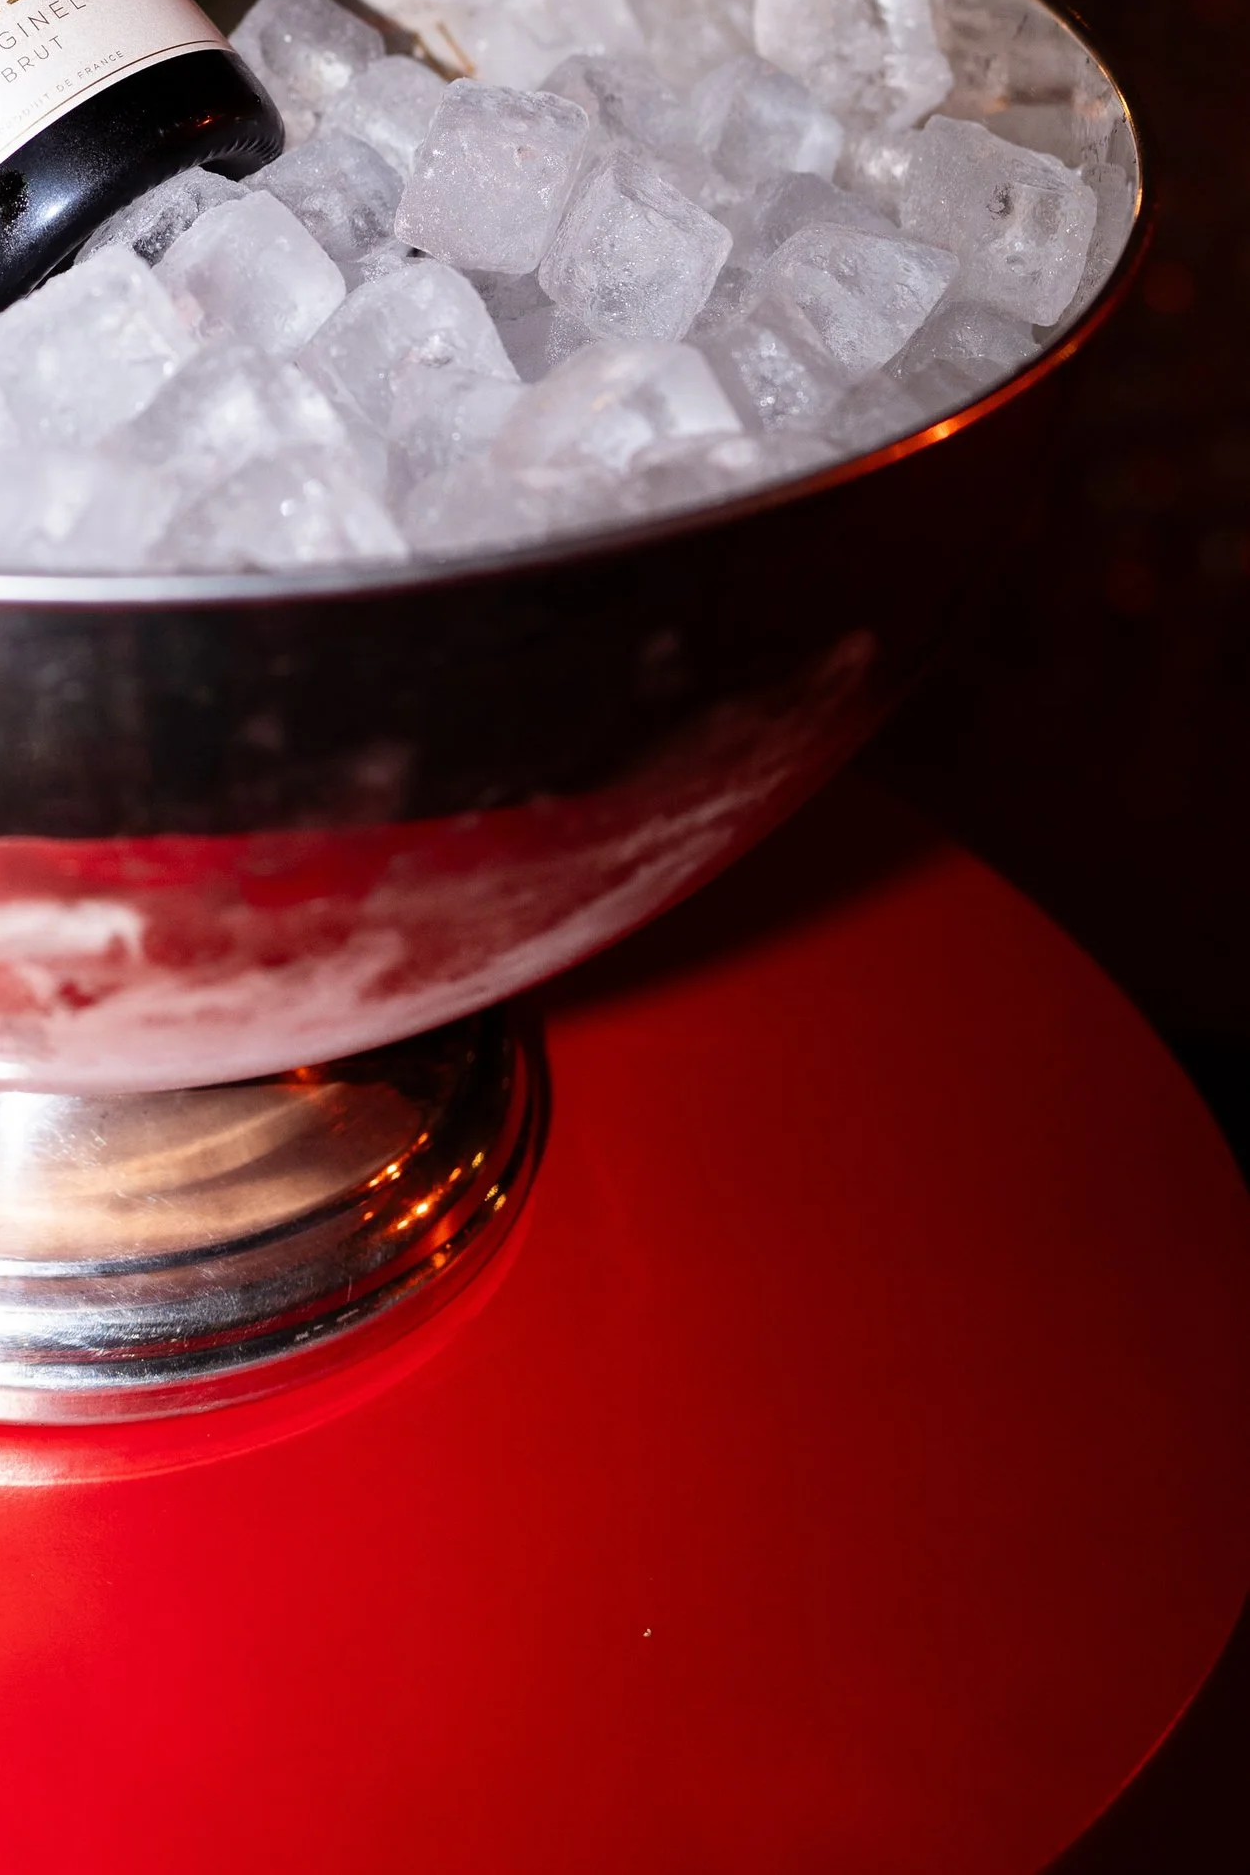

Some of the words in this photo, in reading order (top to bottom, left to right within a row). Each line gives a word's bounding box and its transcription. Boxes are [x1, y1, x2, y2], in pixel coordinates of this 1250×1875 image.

[0, 36, 64, 84] BRUT
[56, 79, 73, 93] DE
[77, 50, 125, 80] FRANCE
